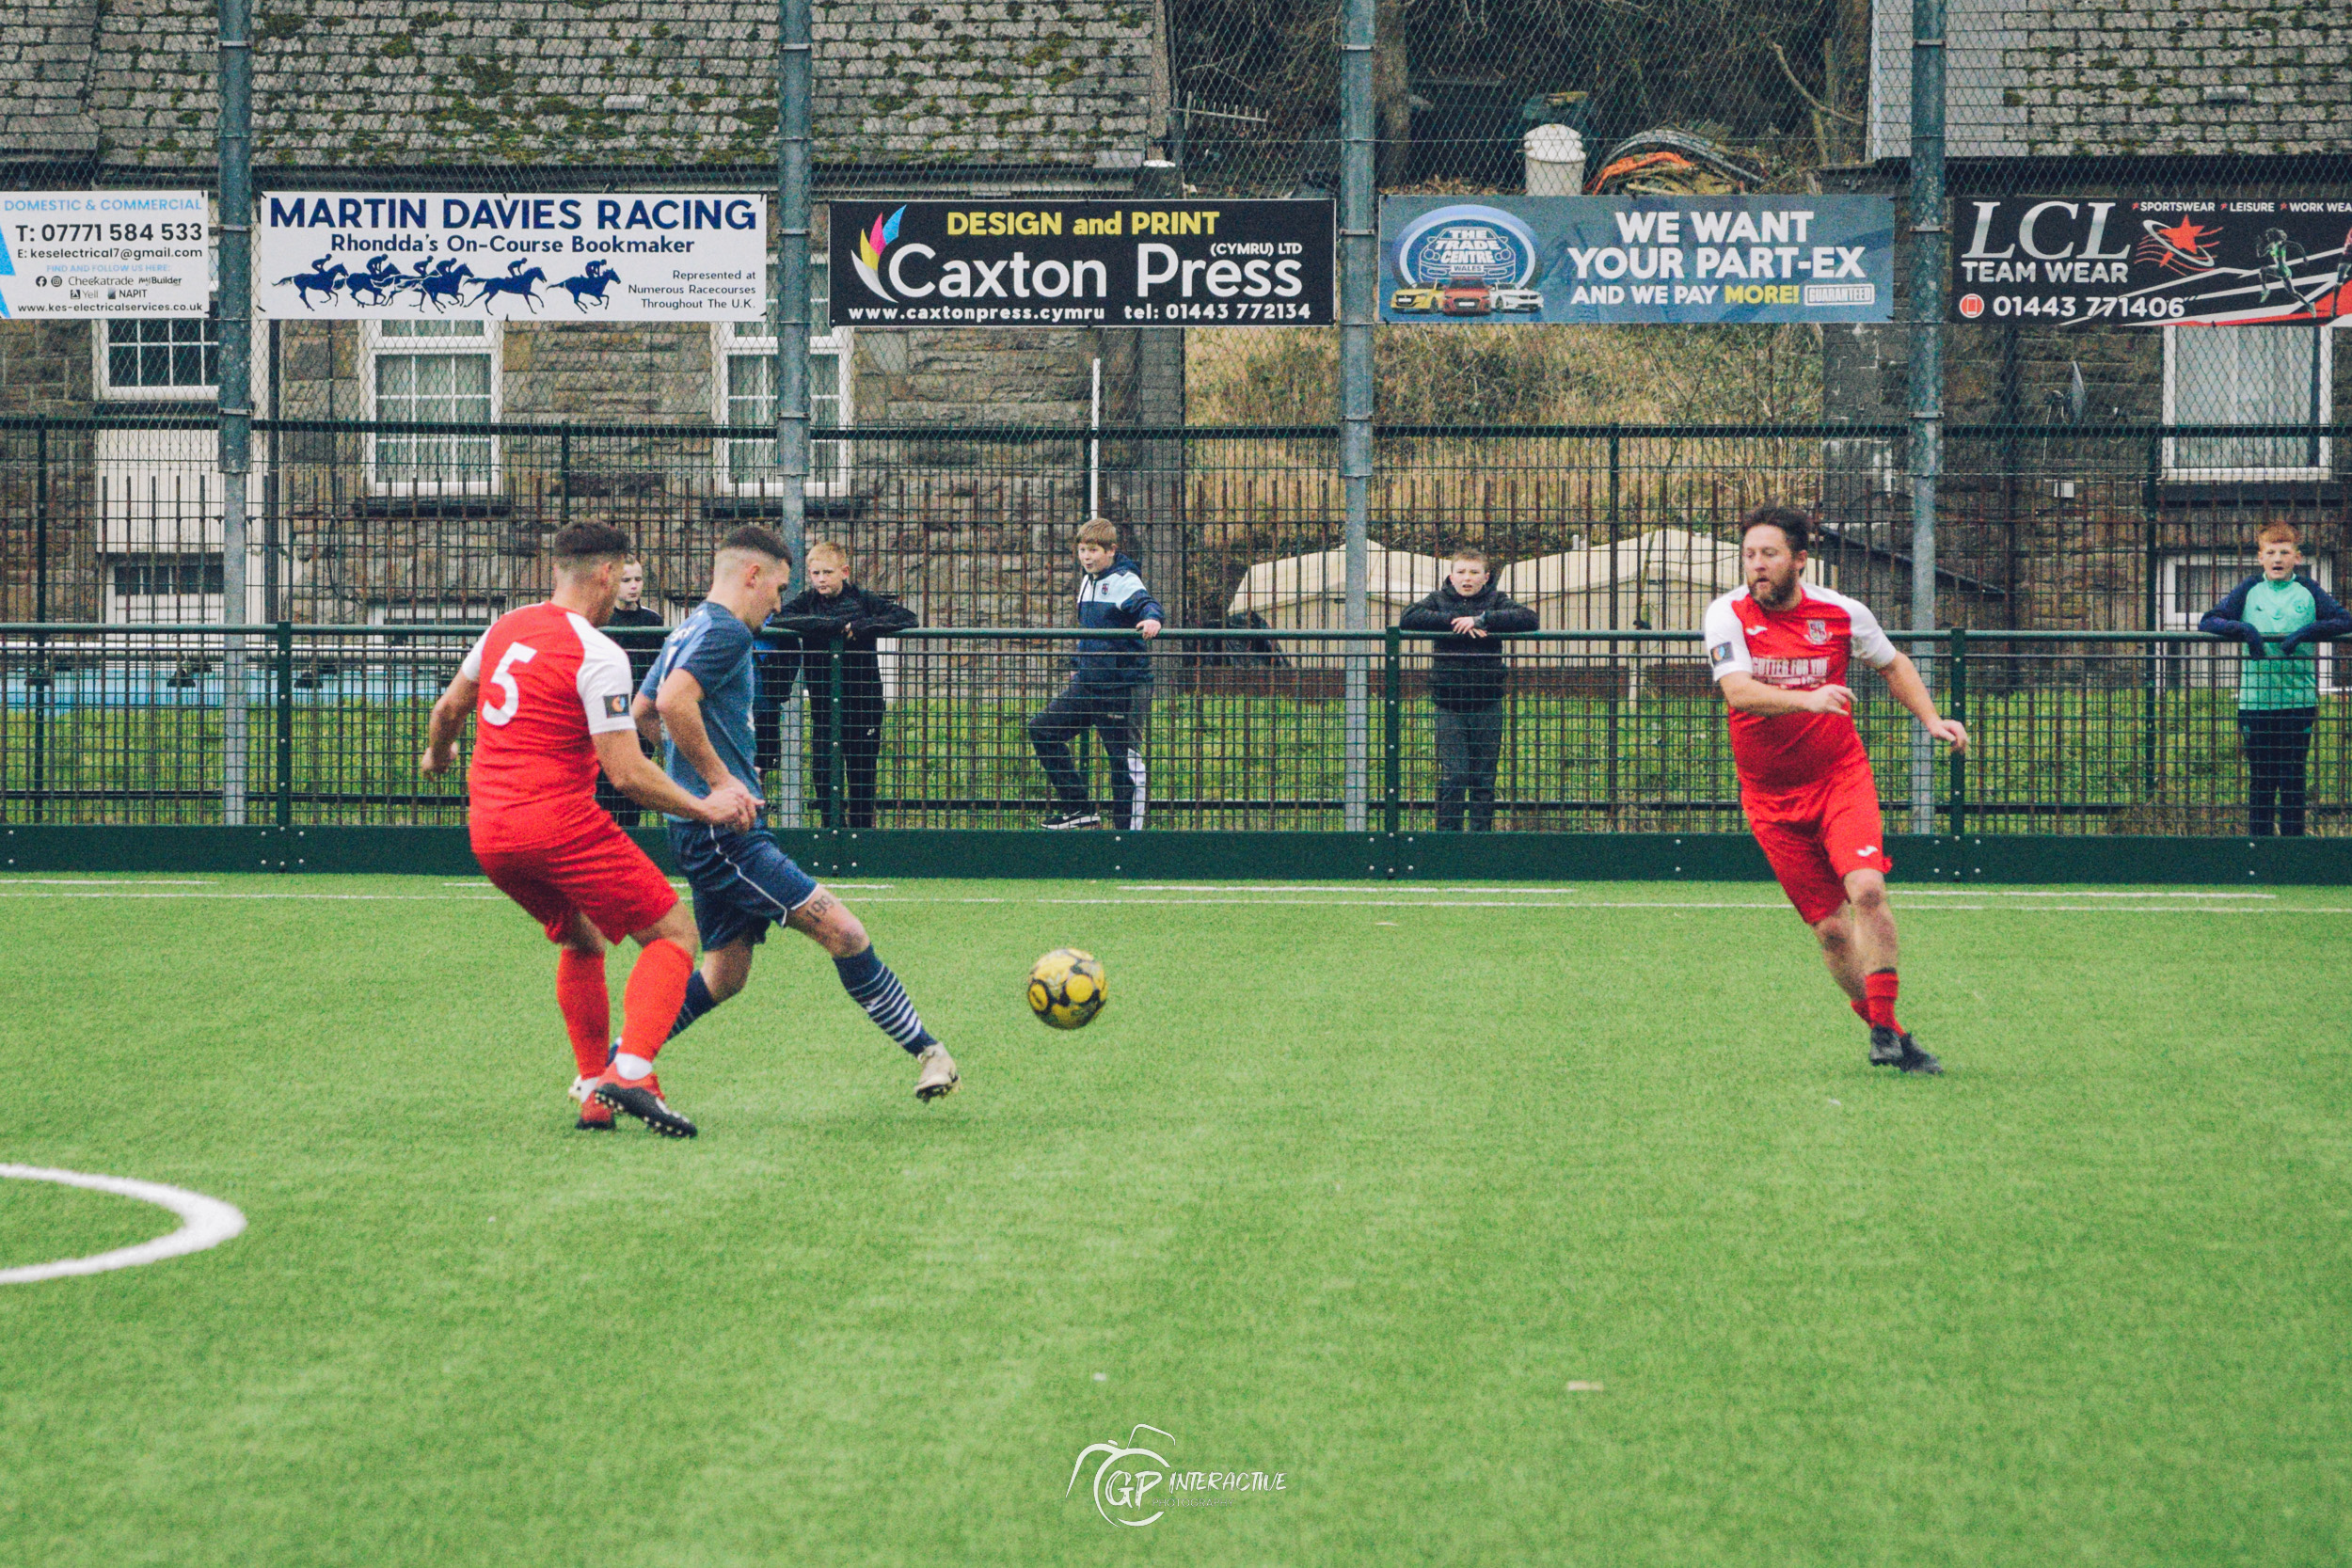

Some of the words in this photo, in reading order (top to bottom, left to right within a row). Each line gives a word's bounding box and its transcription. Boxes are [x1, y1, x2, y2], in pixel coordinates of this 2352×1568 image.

[4, 199, 82, 212] DOMESTIC
[86, 199, 96, 211] &
[101, 198, 202, 211] COMMERCIAL
[2140, 202, 2216, 213] SPORTSWEAR
[2230, 202, 2275, 212] LEISURE
[2289, 202, 2324, 213] WORK
[270, 197, 427, 229] MARTIN
[442, 198, 582, 230] DAVIES
[597, 199, 756, 230] RACING
[947, 212, 1062, 235] DESIGN
[1073, 211, 1122, 235] and
[1132, 211, 1220, 234] PRINT
[1615, 212, 1680, 244] WE
[1691, 211, 1814, 243] WANT
[1961, 200, 2131, 260] LCL
[15, 225, 35, 242] T:
[41, 224, 102, 242] 07771
[109, 224, 153, 241] 584
[161, 223, 202, 241] 533
[1449, 230, 1487, 240] THE
[331, 233, 438, 252] Rhondda's
[447, 234, 564, 253] On-Course
[571, 234, 695, 253] Bookmaker
[1210, 243, 1274, 257] (CYMRU)
[1278, 242, 1302, 255] LTD
[1434, 240, 1502, 250] TRADE
[18, 249, 27, 259] E:
[31, 246, 202, 261] keselectrical7@gmail.com
[1440, 250, 1496, 264] CENTRE
[46, 264, 68, 273] FIND
[70, 264, 90, 273] AND
[92, 264, 129, 273] FOLLOW
[132, 264, 142, 273] US
[146, 264, 170, 273] HERE:
[1567, 247, 1685, 279] YOUR
[1696, 246, 1867, 279] PART-EX
[673, 270, 741, 281] Represented
[746, 271, 756, 280] at
[888, 243, 1107, 298] Caxton
[1136, 243, 1303, 298] Press
[1961, 261, 2037, 282] TEAM
[2045, 261, 2129, 283] WEAR
[68, 276, 134, 287] Checkatrade
[628, 284, 685, 294] Numerous
[689, 284, 756, 294] Racecourses
[82, 290, 99, 299] Yell
[119, 289, 148, 298] NAPIT
[1570, 286, 1625, 305] AND
[1630, 286, 1668, 304] WE
[1675, 286, 1719, 304] PAY
[1724, 285, 1800, 304] MORE!
[1808, 287, 1871, 302] GUARANTEED
[18, 302, 202, 312] www.kes-electricalservices.co.uk
[641, 298, 703, 310] Throughout
[707, 298, 727, 309] The
[731, 299, 755, 309] U.K.
[1993, 295, 2076, 317] 01443
[2086, 295, 2185, 318] 771406
[848, 305, 1105, 323] www.caxtonpress.cymru
[1124, 304, 1159, 320] tel:
[1166, 304, 1229, 320] 01443
[1236, 303, 1311, 320] 772134
[482, 641, 538, 726] 5
